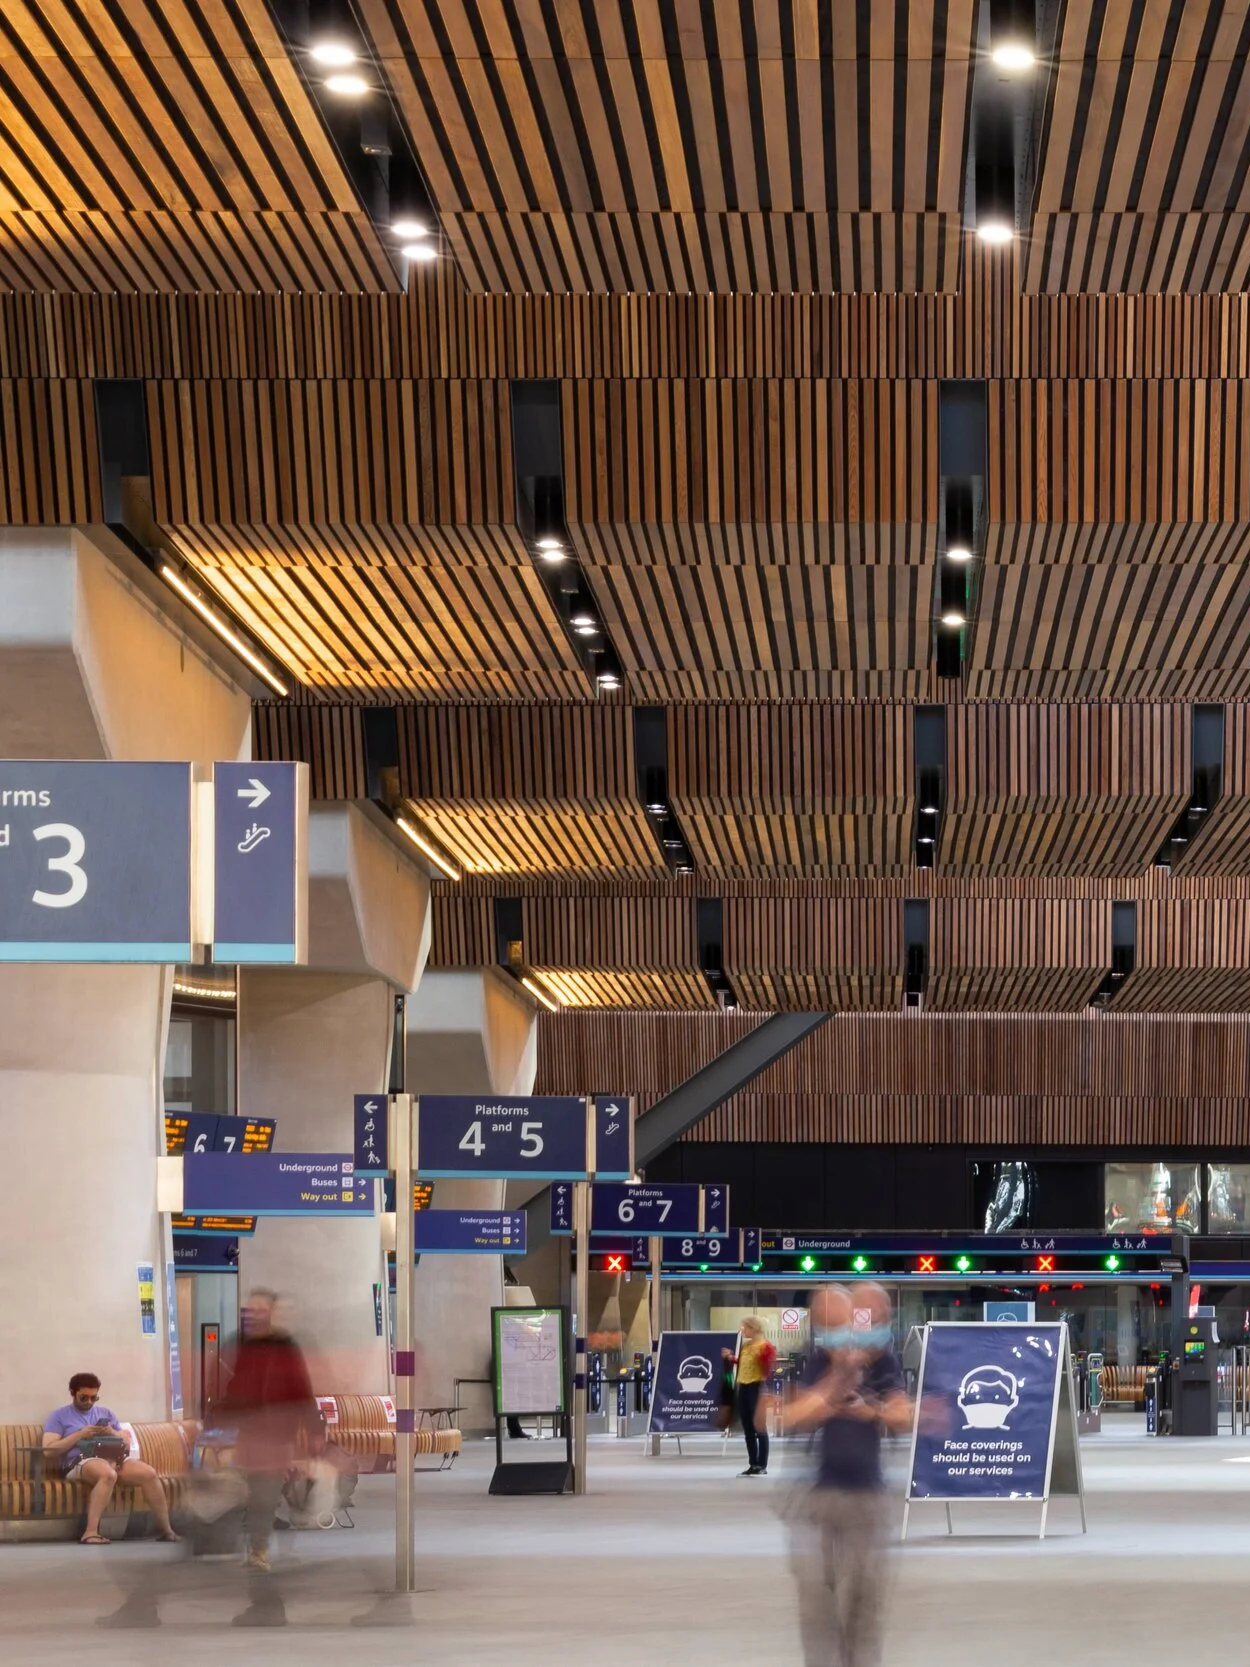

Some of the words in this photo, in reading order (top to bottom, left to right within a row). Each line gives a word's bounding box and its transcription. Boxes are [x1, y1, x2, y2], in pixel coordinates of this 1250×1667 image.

[0, 789, 51, 806] rms
[32, 823, 88, 908] 3
[475, 1104, 529, 1116] Platforms
[459, 1121, 486, 1156] 4
[491, 1121, 512, 1132] and
[520, 1122, 544, 1157] 5
[279, 1163, 338, 1174] Underground
[311, 1178, 338, 1187] Buses
[300, 1192, 320, 1202] Way
[322, 1193, 338, 1201] out
[628, 1188, 663, 1197] Platforms
[618, 1199, 635, 1222] 6
[656, 1200, 673, 1223] 7
[459, 1216, 500, 1225] Underground
[474, 1237, 488, 1245] Way
[798, 1240, 850, 1250] Underground
[681, 1239, 694, 1256] 8
[708, 1239, 721, 1257] 9
[944, 1441, 969, 1450] Face
[970, 1440, 1023, 1452] coverings
[932, 1453, 969, 1462] should
[972, 1453, 986, 1462] be
[988, 1453, 1015, 1462] used
[948, 1467, 967, 1475] our
[969, 1466, 1014, 1476] services
